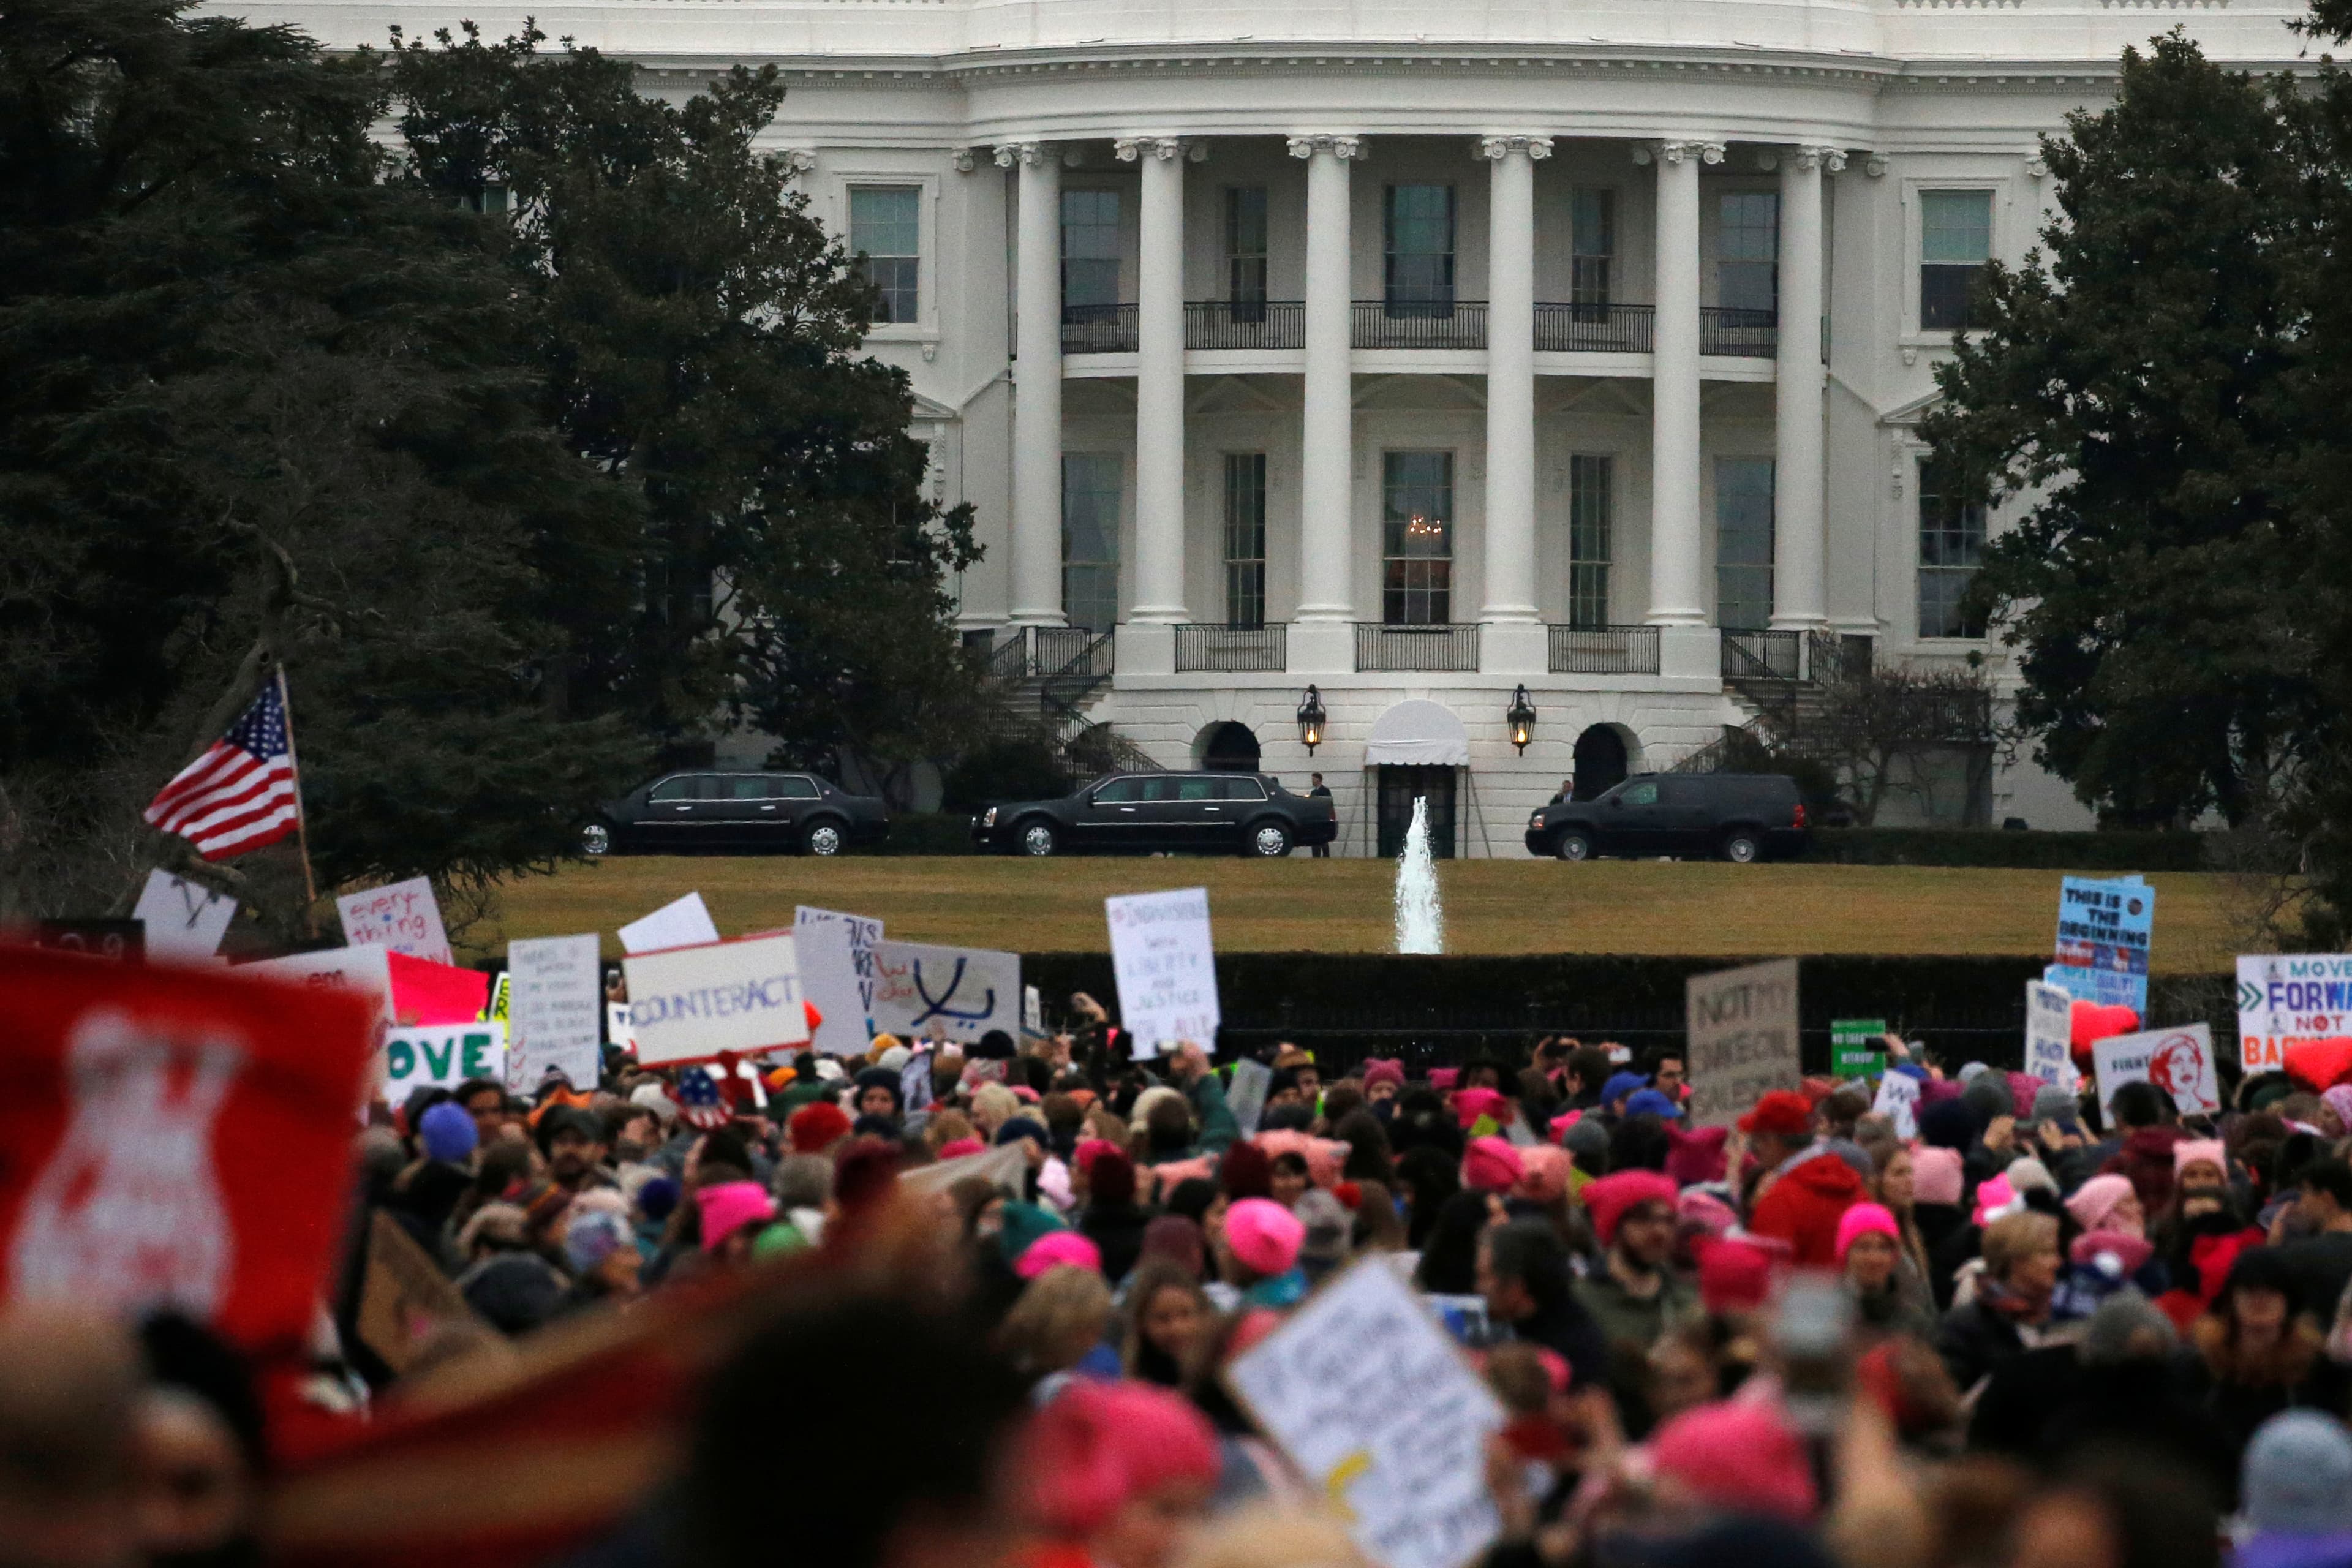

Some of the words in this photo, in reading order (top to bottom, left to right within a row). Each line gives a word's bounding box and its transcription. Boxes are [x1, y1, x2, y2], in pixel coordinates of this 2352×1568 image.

[2065, 888, 2103, 906] THIS
[2105, 894, 2120, 908] IS
[2087, 908, 2120, 926] THE
[2059, 920, 2147, 947] BEGINNING
[2290, 961, 2352, 977] MOVE
[631, 973, 796, 1028] COUNTERACT
[2295, 1014, 2344, 1032] NOT
[387, 1033, 492, 1081] OVE
